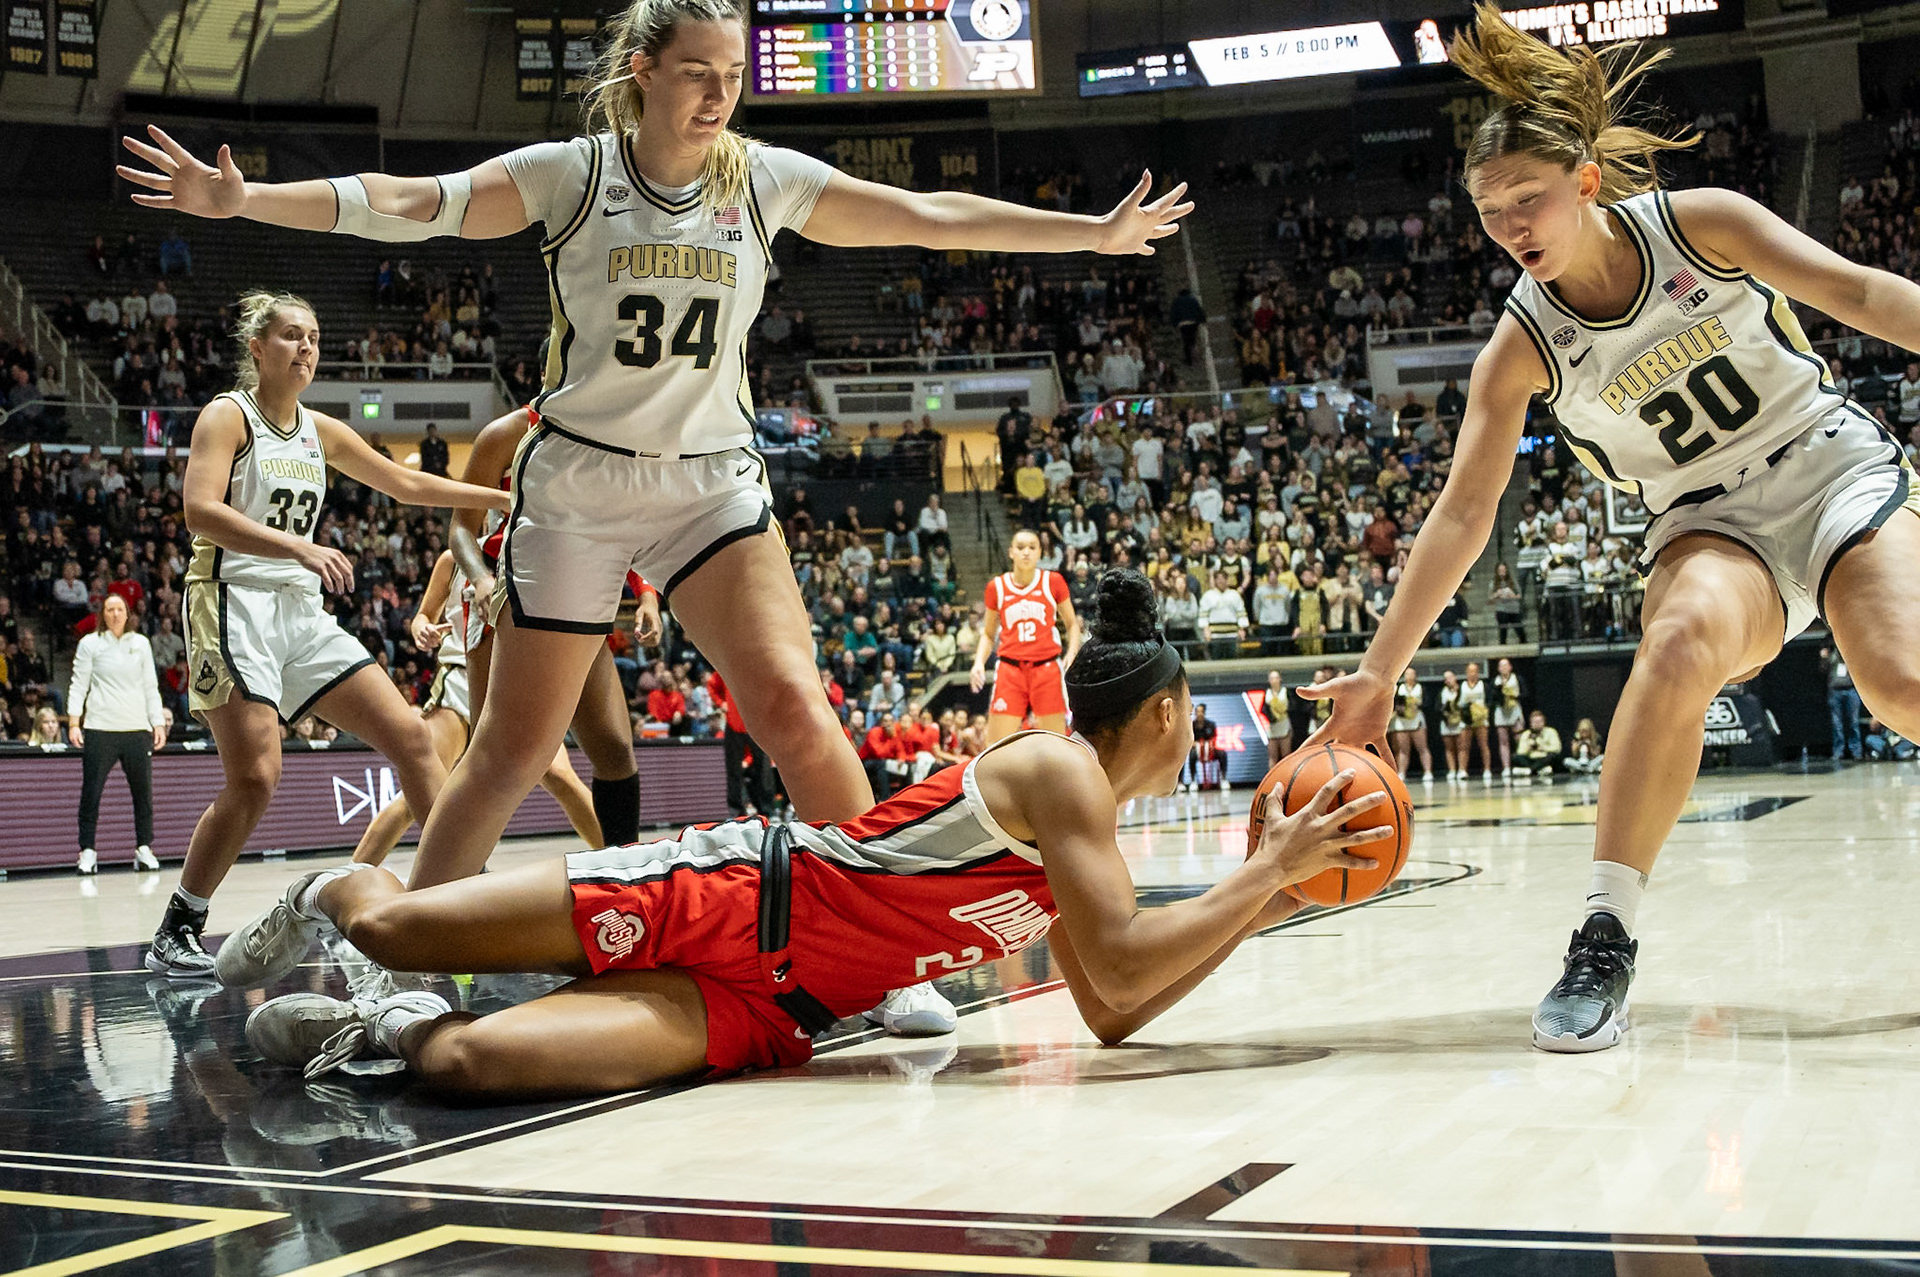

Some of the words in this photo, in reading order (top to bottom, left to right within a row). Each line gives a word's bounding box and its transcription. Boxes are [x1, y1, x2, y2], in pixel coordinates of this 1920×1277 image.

[1594, 0, 1718, 22] BASKETBALL
[1549, 25, 1583, 46] VS.
[1586, 15, 1667, 43] ILLINOIS
[1224, 47, 1249, 61] FEB
[1261, 44, 1269, 57] 5
[1296, 38, 1329, 54] 8:00
[1335, 35, 1359, 49] PM
[1362, 129, 1431, 143] WABASH
[837, 138, 913, 164] PAINT
[940, 155, 978, 177] 104
[608, 244, 736, 288] PURDUE
[614, 294, 720, 370] 34
[1599, 315, 1733, 415] PURDUE
[1639, 355, 1760, 465] 20
[260, 458, 323, 487] PURDUE
[267, 488, 318, 536] 33
[1017, 621, 1037, 643] 12
[1704, 729, 1749, 746] ONEER
[915, 946, 983, 977] 2
